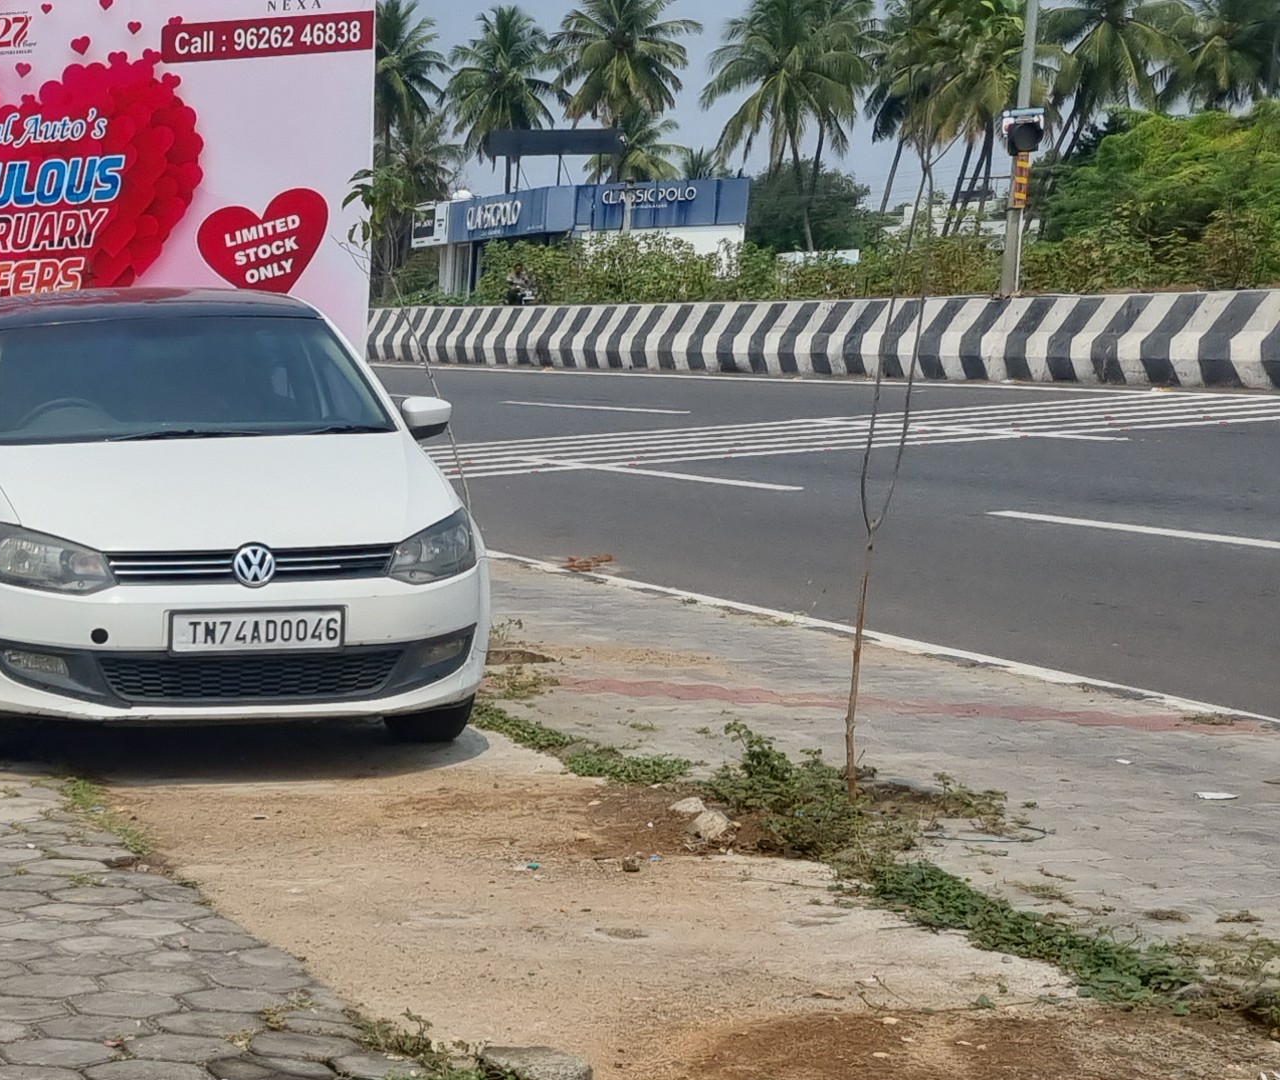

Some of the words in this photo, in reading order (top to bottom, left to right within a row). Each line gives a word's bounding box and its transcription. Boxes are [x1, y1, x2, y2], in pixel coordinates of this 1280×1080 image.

[267, 0, 321, 12] NEXA
[174, 32, 214, 55] Call
[233, 25, 293, 51] 96262
[300, 20, 361, 46] 46838
[13, 107, 108, 148] Auto's
[224, 214, 301, 248] LIMITED
[234, 235, 299, 266] STOCK
[245, 258, 293, 284] ONLY
[188, 616, 339, 645] TN74AD0046
